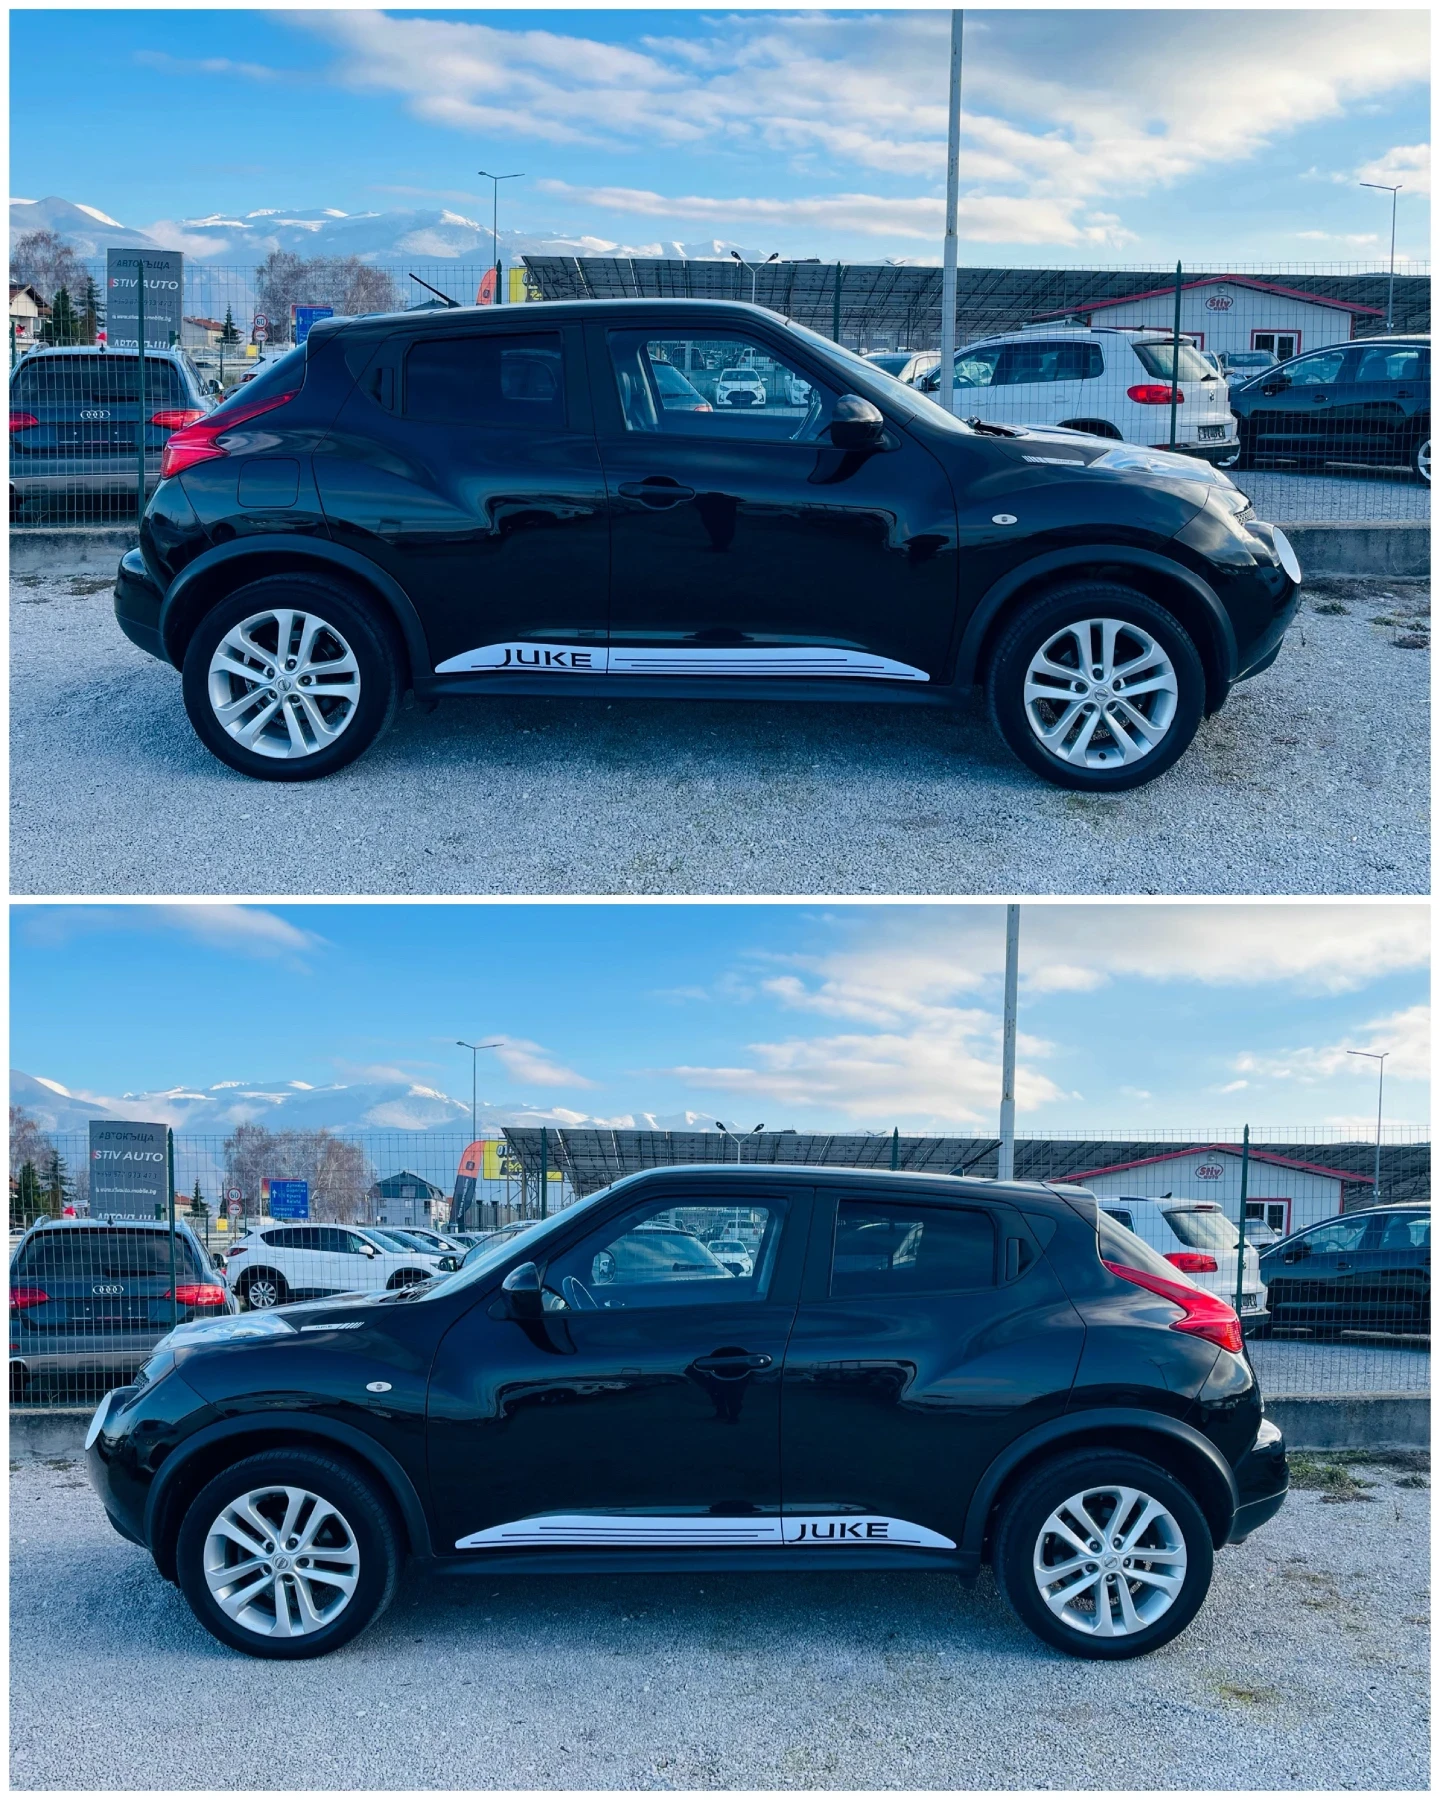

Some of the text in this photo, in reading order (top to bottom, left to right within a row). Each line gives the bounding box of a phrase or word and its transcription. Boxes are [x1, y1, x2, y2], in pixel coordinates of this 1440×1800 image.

[116, 259, 170, 270] АВТОЪЩА
[112, 278, 179, 290] STIV AUTO
[256, 318, 265, 326] 60
[495, 649, 592, 668] JUKE
[94, 1150, 164, 1162] STIV AUTO
[1199, 1166, 1220, 1176] Stiv
[230, 1190, 239, 1198] 60
[788, 1522, 889, 1543] JUKE
